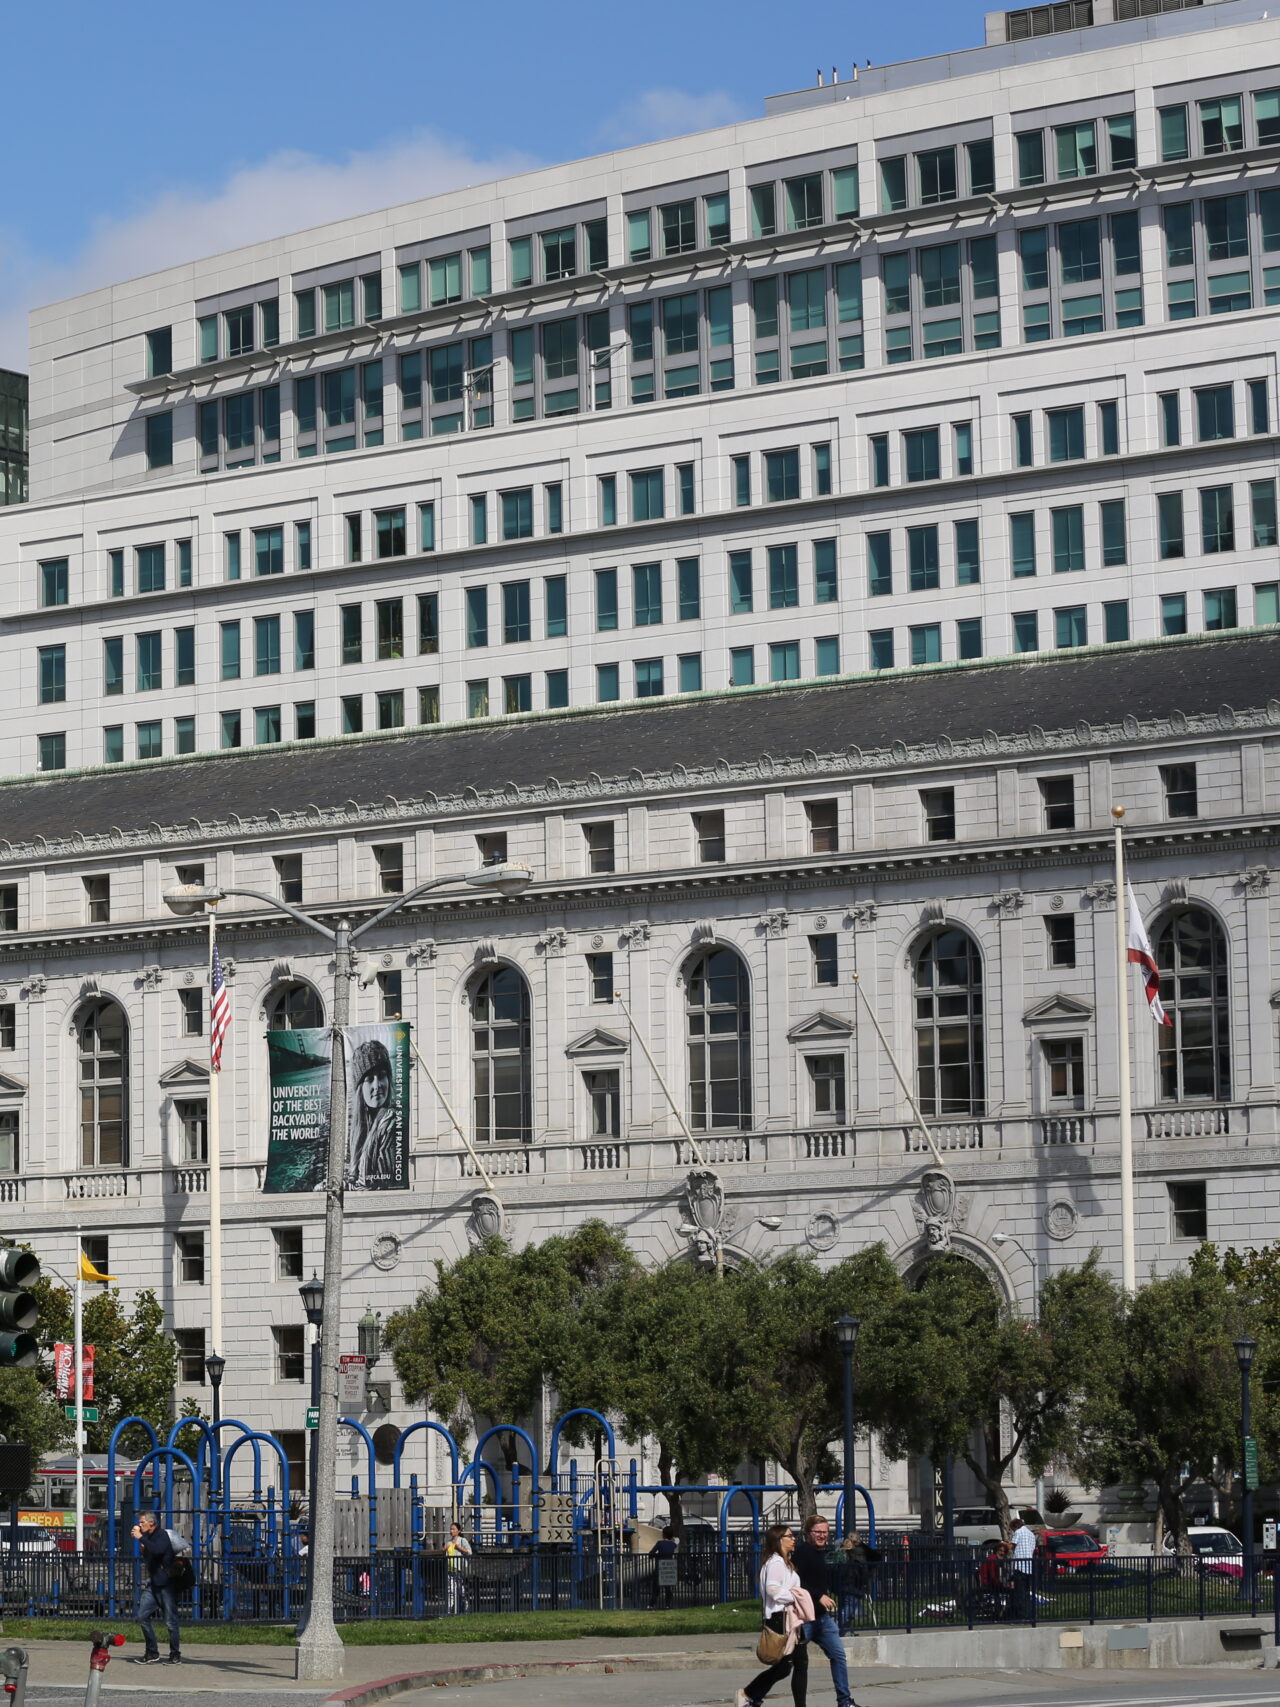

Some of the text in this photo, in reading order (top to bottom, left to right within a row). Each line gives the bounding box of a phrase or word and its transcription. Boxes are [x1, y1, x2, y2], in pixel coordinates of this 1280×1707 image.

[395, 1046, 403, 1099] UNIVERSITY
[273, 1085, 320, 1098] UNIVERSITY
[273, 1099, 322, 1112] OF THE BEST
[395, 1100, 402, 1108] of
[273, 1112, 326, 1126] BACKYARD IN
[272, 1129, 288, 1140] THE
[60, 1344, 72, 1399] SYMPHONY
